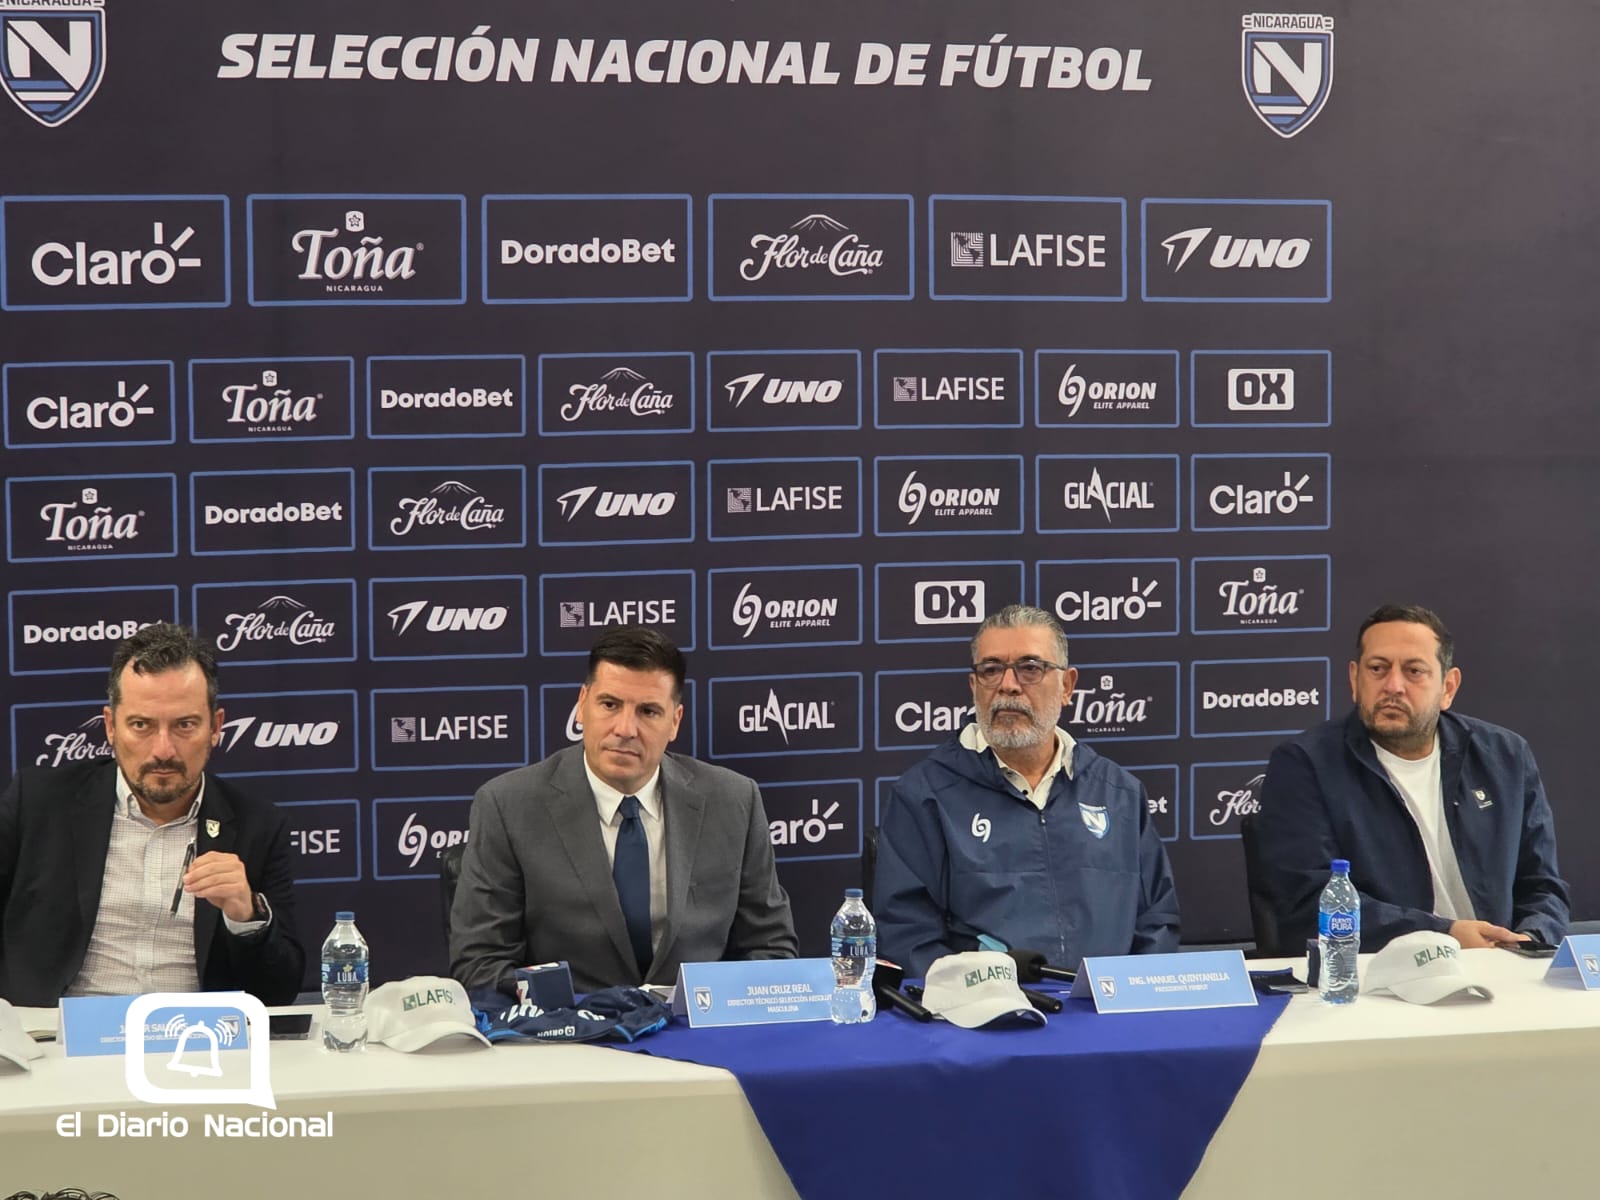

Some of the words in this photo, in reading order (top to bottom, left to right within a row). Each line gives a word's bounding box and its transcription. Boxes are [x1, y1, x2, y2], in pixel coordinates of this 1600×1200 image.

[1253, 15, 1323, 30] NICARAGUA
[216, 25, 540, 83] SELECCIÓN
[550, 38, 841, 85] NACIONAL
[853, 42, 931, 86] DE
[939, 33, 1152, 91] FÚTBOL
[292, 229, 416, 280] Toña
[501, 237, 676, 265] DoradoBet
[740, 234, 808, 281] Flor
[828, 234, 883, 275] Caña
[990, 233, 1106, 267] LAFISE
[1211, 235, 1310, 269] UNO
[32, 242, 176, 286] Claro
[326, 284, 383, 292] NICARAGUA
[380, 387, 513, 409] DoradoBet
[561, 383, 616, 422] Flor
[629, 382, 673, 416] Caña
[763, 378, 843, 404] UNO
[921, 377, 1005, 401] LAFISE
[1088, 382, 1157, 400] ORION
[1236, 373, 1286, 405] OX
[27, 397, 136, 429] Claro
[222, 384, 316, 423] Toña
[1093, 401, 1114, 410] ELITE
[1115, 401, 1150, 410] APPAREL
[595, 492, 675, 517] UNO
[756, 485, 842, 511] LAFISE
[930, 488, 1000, 506] ORION
[1064, 467, 1154, 522] GLACIAL
[1210, 484, 1298, 515] Claro
[41, 502, 139, 541] Toña
[205, 502, 342, 525] DoradoBet
[391, 497, 447, 536] Flor
[460, 496, 504, 529] Caña
[935, 508, 956, 516] ELITE
[958, 507, 993, 516] APPAREL
[67, 543, 113, 551] NICARAGUA
[589, 599, 676, 626] LAFISE
[765, 598, 837, 618] ORION
[923, 585, 977, 619] OX
[1056, 591, 1146, 621] Claro
[1219, 581, 1298, 617] Toña
[24, 620, 162, 644] DoradoB
[217, 612, 274, 652] Flor
[288, 610, 335, 645] Caña
[427, 606, 508, 632] UNO
[770, 620, 793, 629] ELITE
[795, 618, 831, 628] APPAREL
[1069, 688, 1147, 724] Toña
[1203, 688, 1319, 710] DoradoBet
[421, 714, 508, 741] LAFISE
[739, 688, 834, 744] GLACIAL
[895, 701, 976, 733] Clar
[256, 721, 338, 747] UNO
[430, 829, 470, 849] ORI
[768, 818, 827, 845] aro
[977, 965, 1014, 983] LAFIS
[416, 988, 454, 1007] LAFIS
[747, 986, 769, 996] JUAN
[769, 985, 791, 995] CRUZ
[792, 983, 813, 993] REAL
